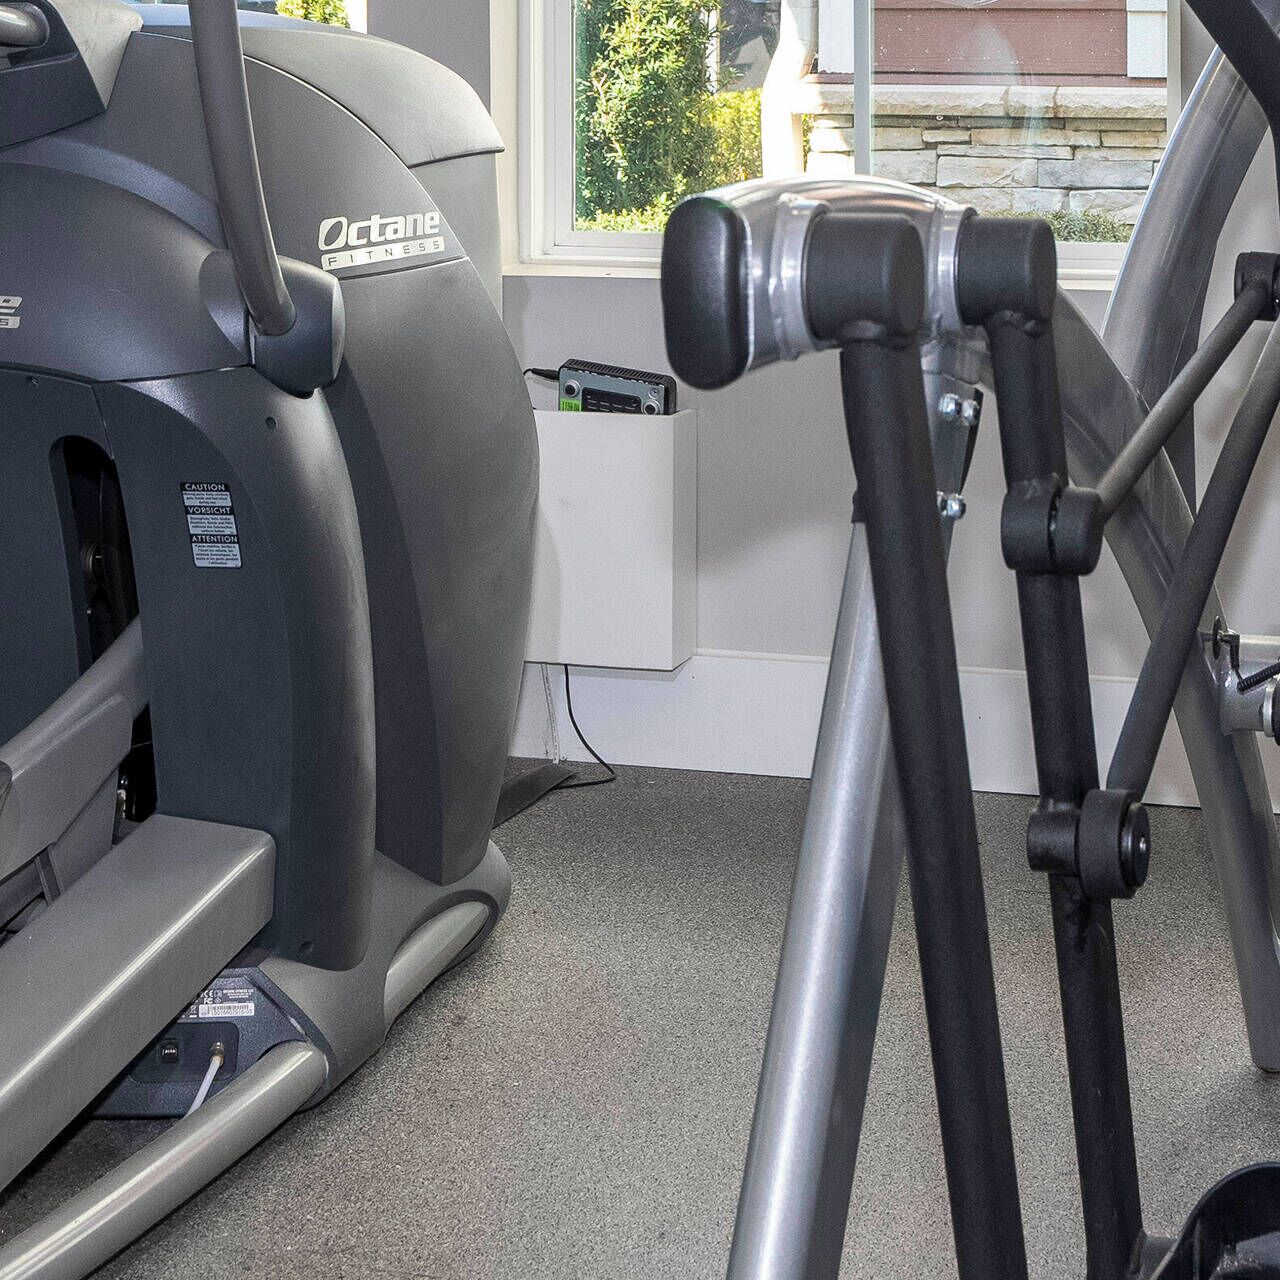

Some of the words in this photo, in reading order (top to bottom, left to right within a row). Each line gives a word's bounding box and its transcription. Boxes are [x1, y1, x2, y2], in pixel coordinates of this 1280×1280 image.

[318, 211, 440, 251] Octane
[328, 241, 440, 267] FITNESS
[185, 483, 225, 491] CAUTION
[192, 535, 238, 543] ATTENTION
